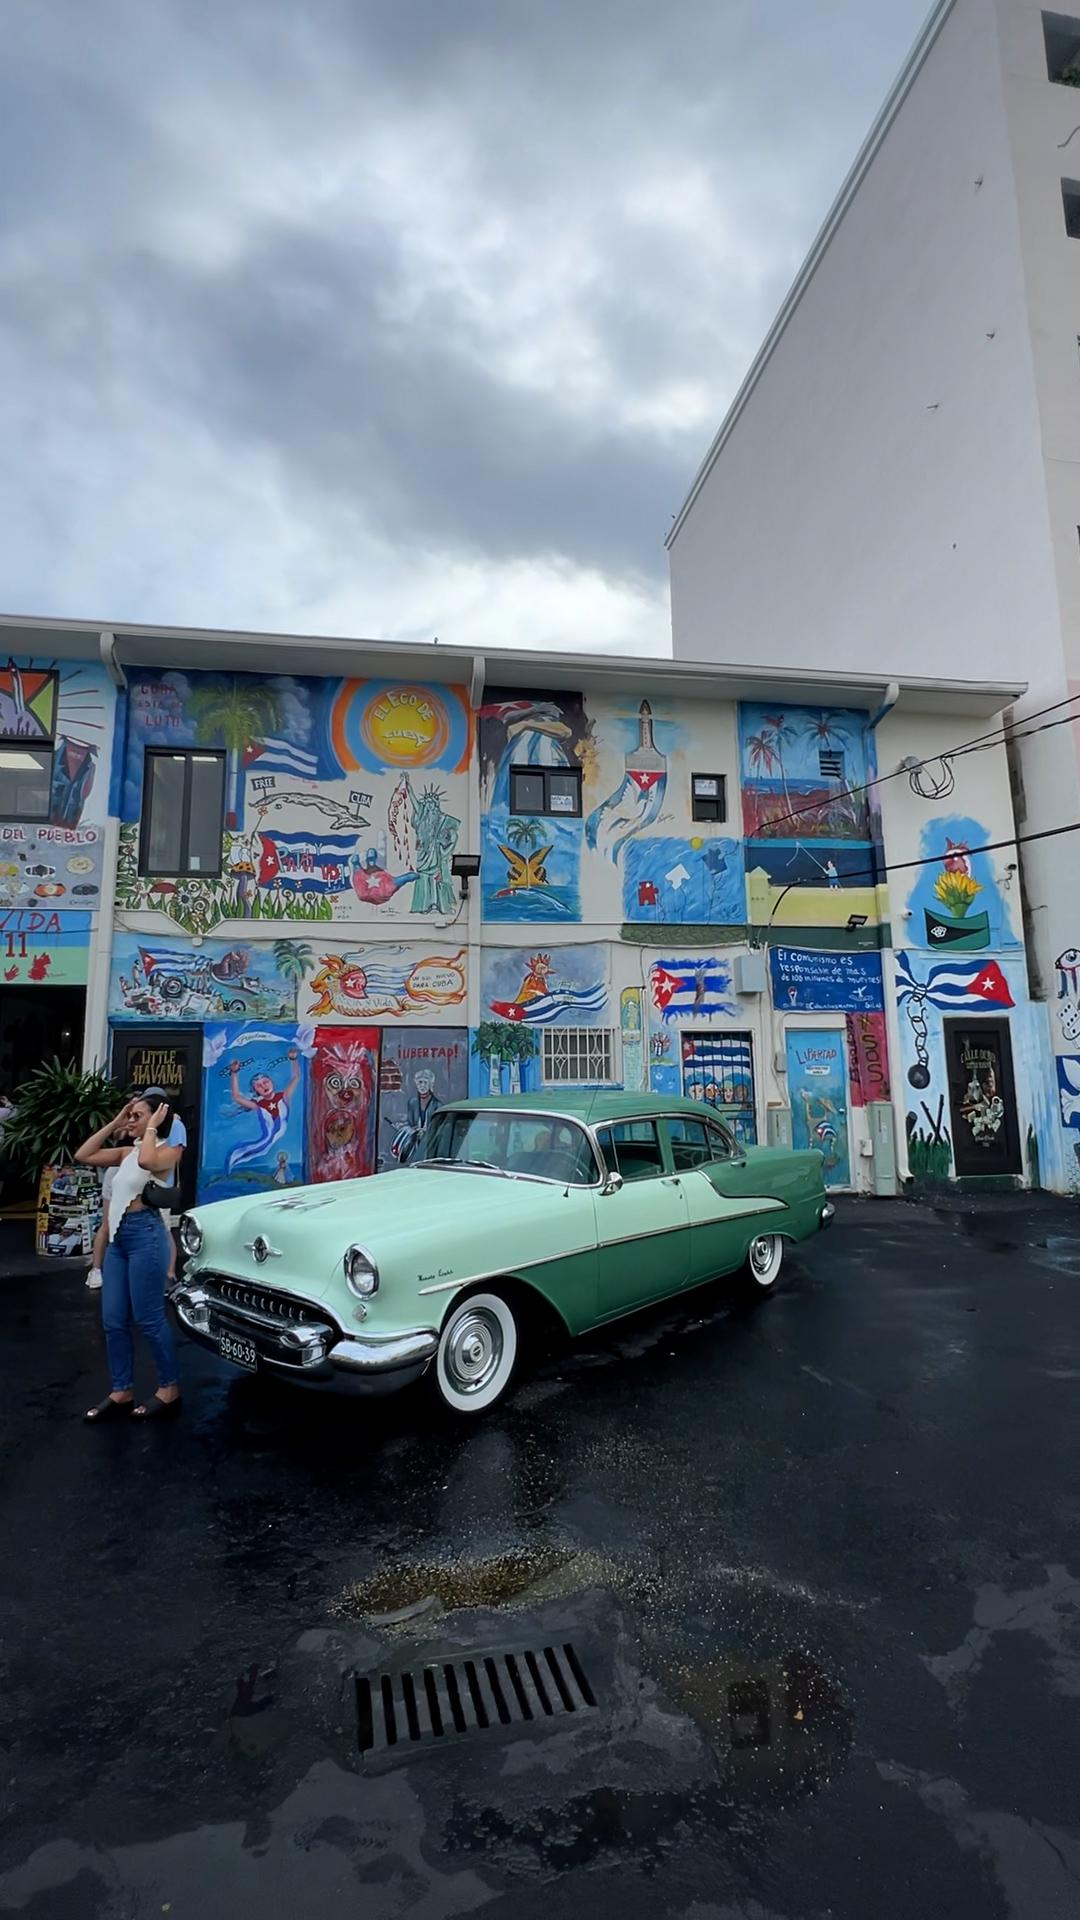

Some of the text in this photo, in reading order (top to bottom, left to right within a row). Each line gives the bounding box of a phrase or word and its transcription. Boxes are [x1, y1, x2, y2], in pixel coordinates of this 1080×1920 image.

[374, 704, 391, 721] EL
[416, 702, 434, 722] DE
[254, 779, 274, 789] FREE
[350, 792, 371, 807] CUBA
[2, 828, 97, 844] DEL PUEBLO
[777, 948, 787, 961] El
[841, 957, 854, 966] es
[831, 967, 842, 976] de
[141, 1050, 177, 1065] LITTLE
[132, 1064, 183, 1085] HAVANA
